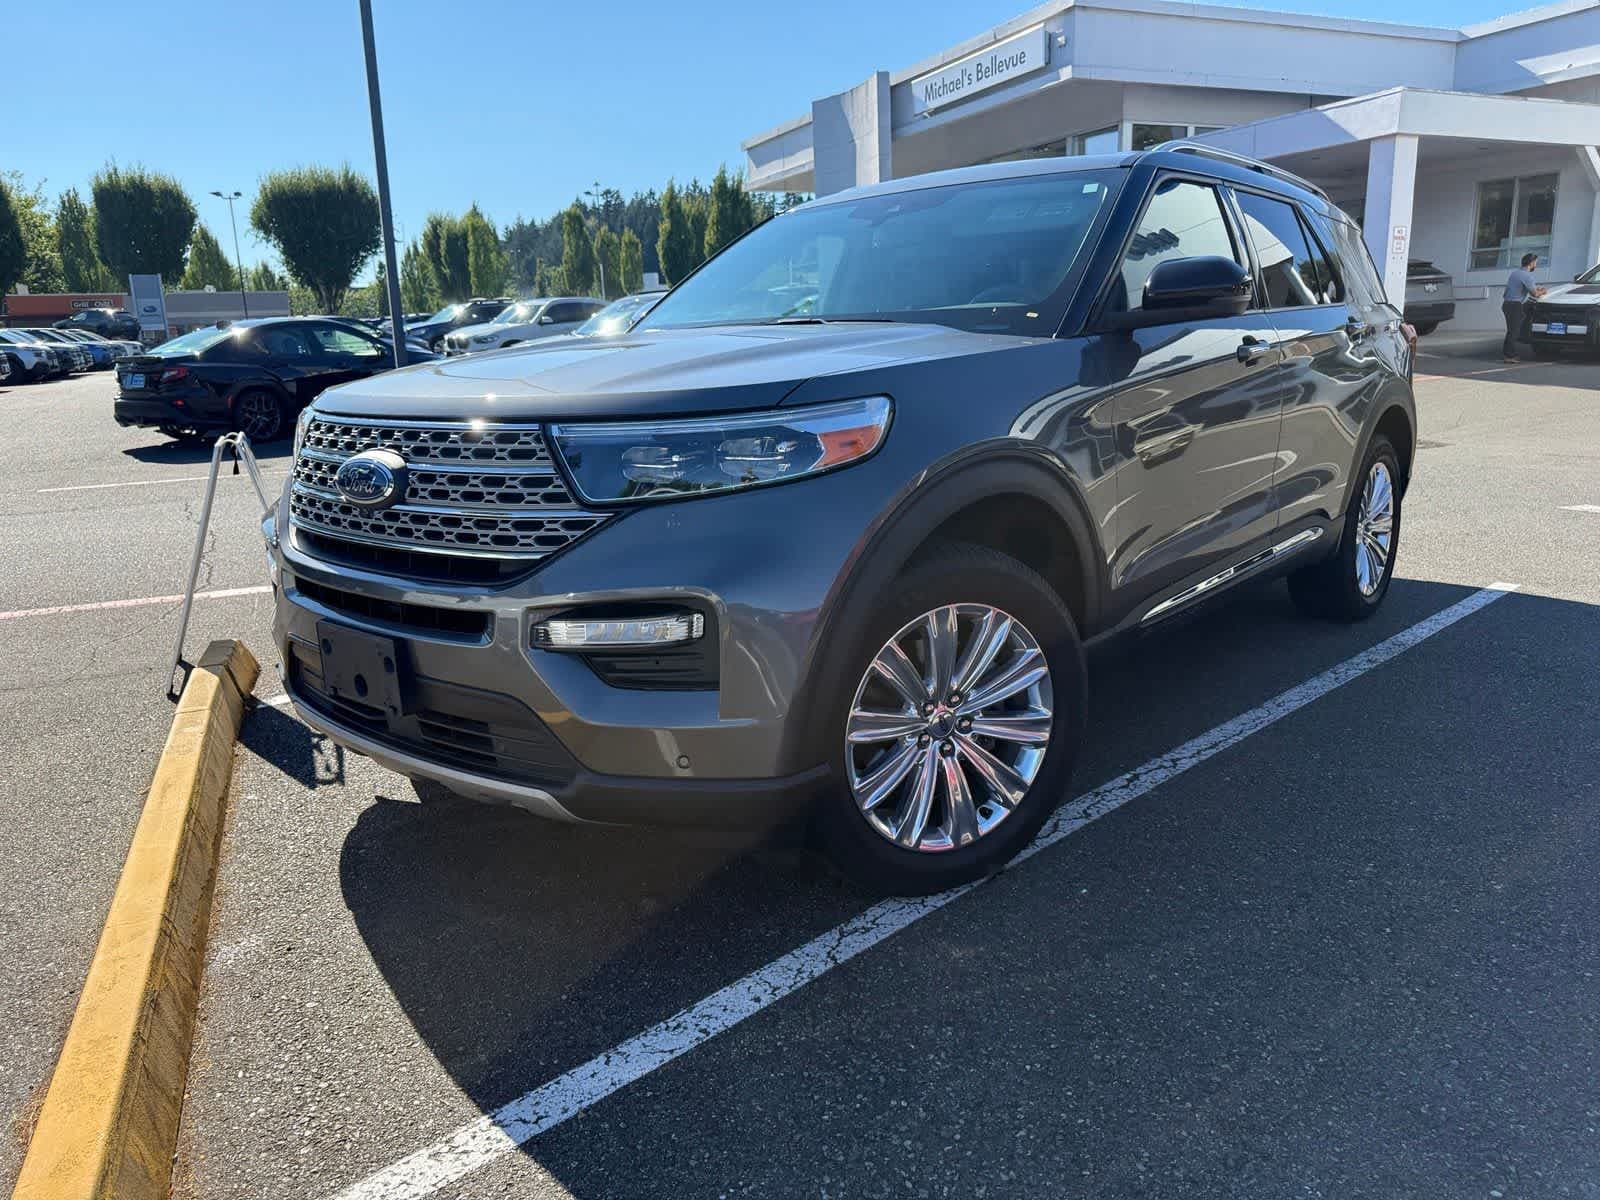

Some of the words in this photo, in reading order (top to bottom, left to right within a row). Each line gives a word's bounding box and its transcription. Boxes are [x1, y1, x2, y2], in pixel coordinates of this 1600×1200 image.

[924, 67, 973, 103] Michael's
[976, 50, 1026, 82] Bellevue
[341, 467, 376, 494] Ford
